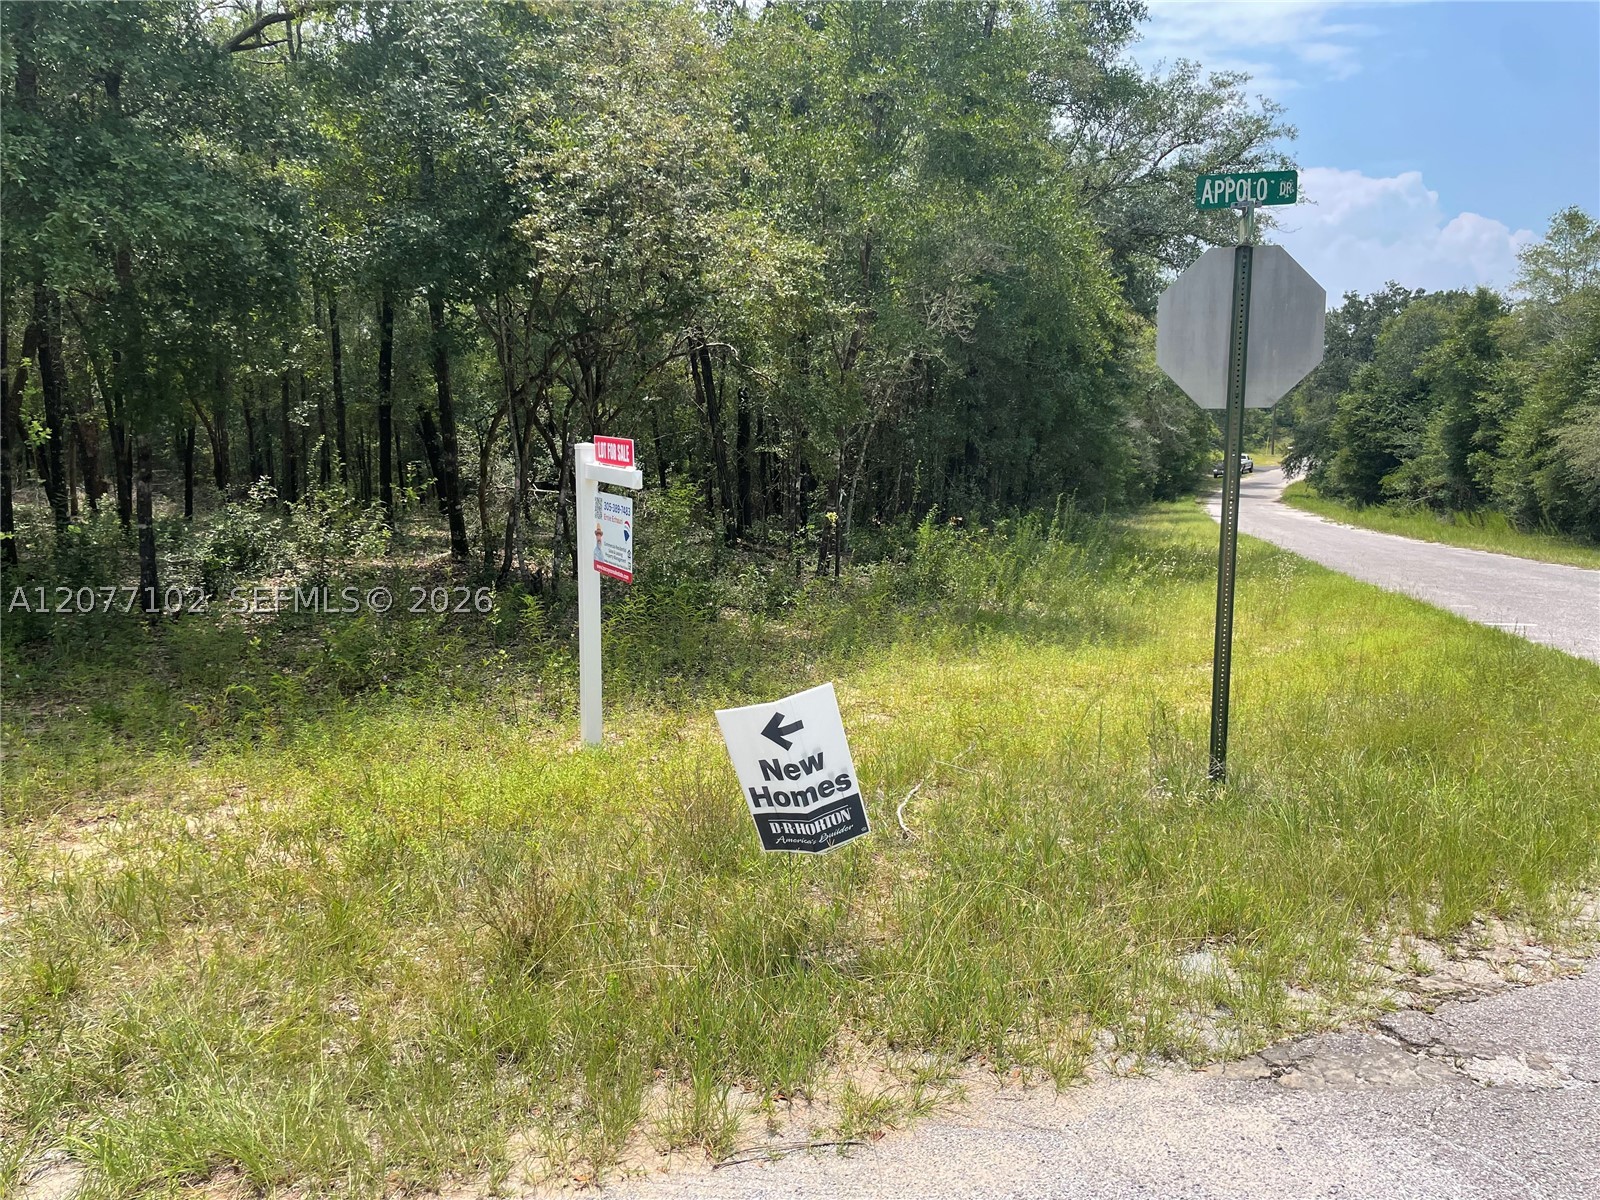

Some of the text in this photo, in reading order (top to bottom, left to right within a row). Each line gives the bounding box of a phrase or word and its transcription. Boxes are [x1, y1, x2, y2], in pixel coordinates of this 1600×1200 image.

[1201, 177, 1268, 205] APPOLO
[597, 441, 630, 463] LOT FOR SALE
[758, 751, 824, 782] New
[748, 773, 852, 808] Homes
[775, 823, 854, 845] America's Builder
